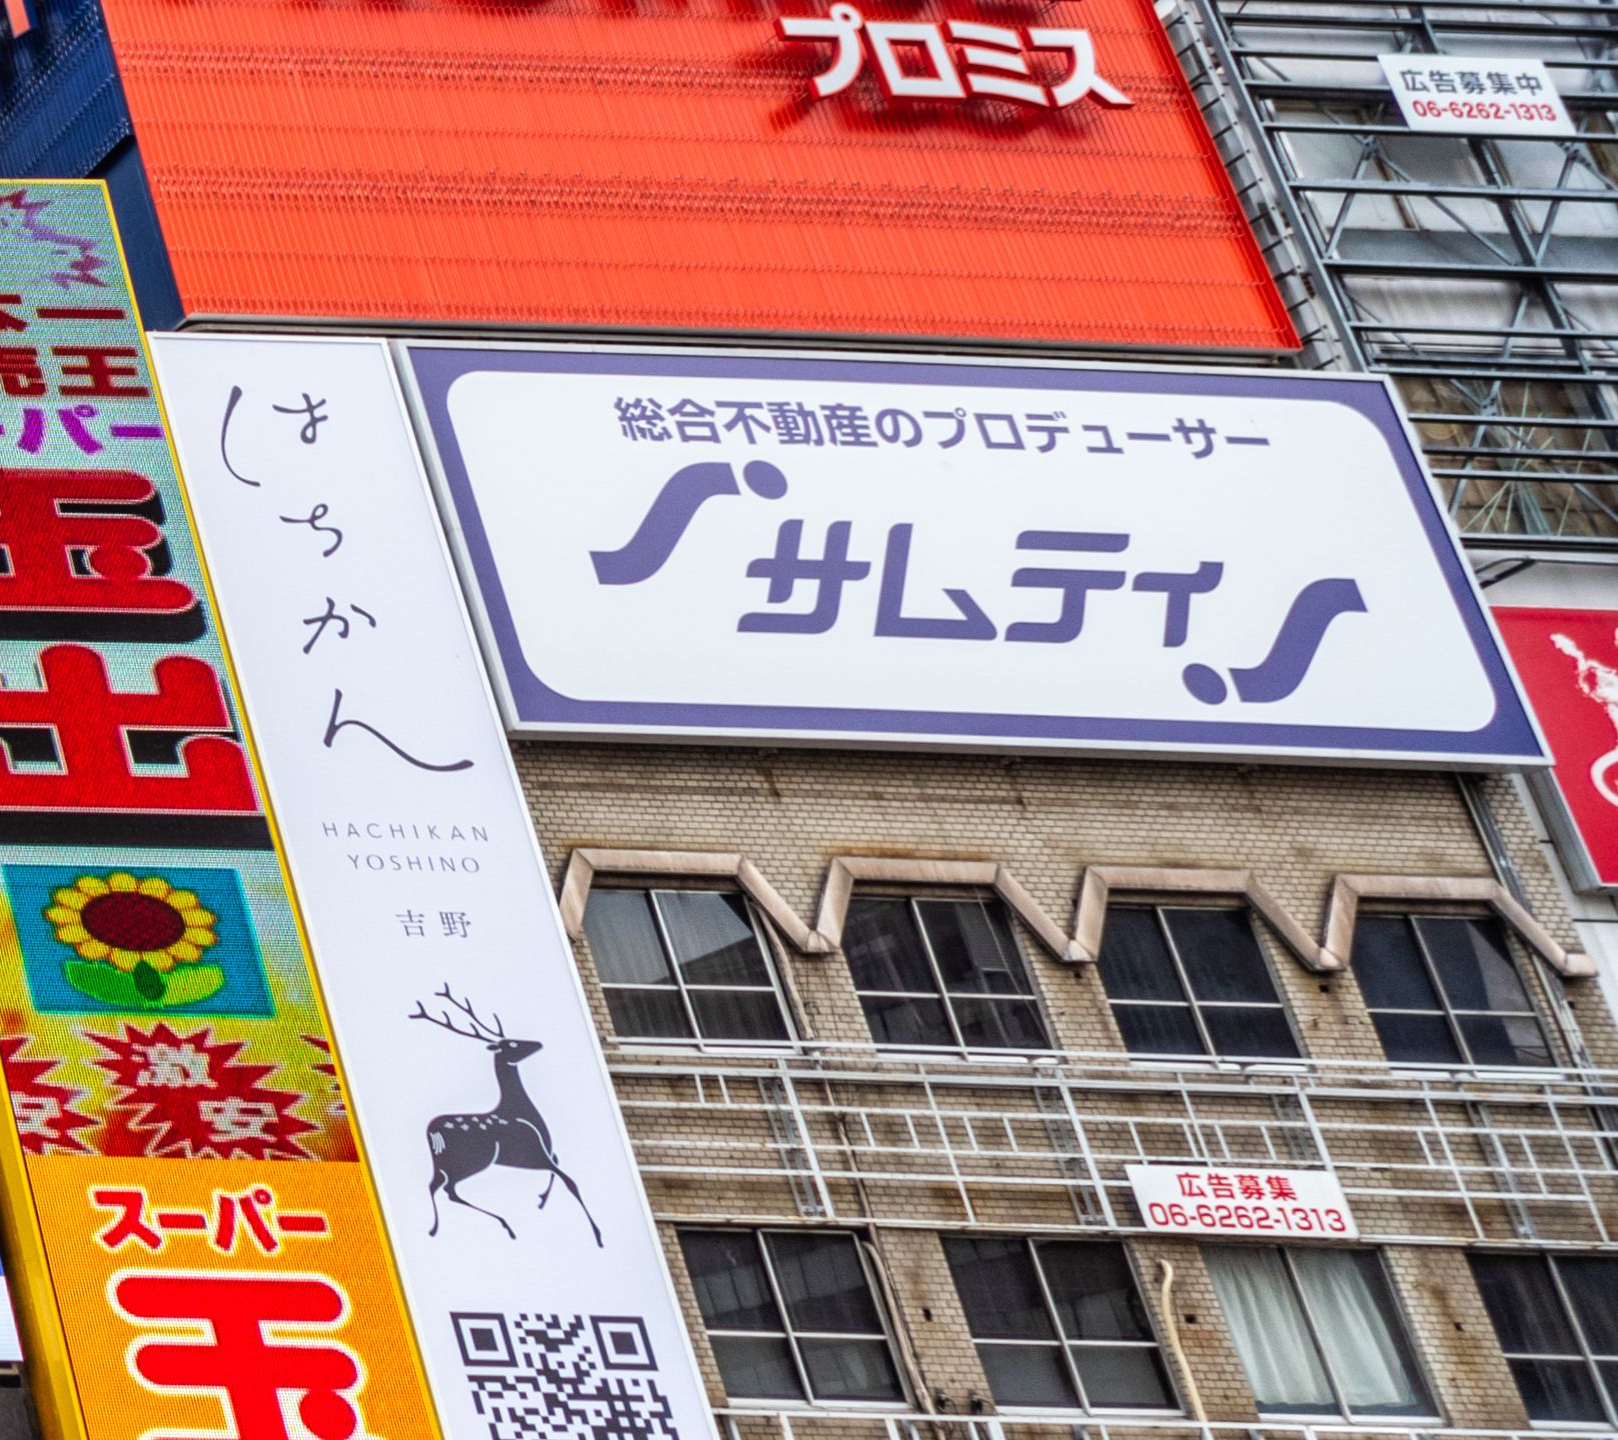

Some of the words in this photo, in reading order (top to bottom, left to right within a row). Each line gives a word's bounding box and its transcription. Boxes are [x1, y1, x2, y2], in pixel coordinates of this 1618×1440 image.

[778, 4, 1134, 109] プロミス
[1399, 69, 1543, 96] 広告募集中
[1412, 99, 1558, 122] 06-6262-1313
[614, 396, 1270, 459] 総合不動産のプロデューサー
[219, 386, 475, 773] はちかん
[322, 819, 491, 843] HACHIKAN
[347, 852, 481, 875] YOSHINO
[395, 908, 473, 940] 吉野
[1176, 1172, 1298, 1201] 広告募集
[92, 1186, 331, 1254] スーパー
[1148, 1203, 1347, 1232] 06-6262-1313
